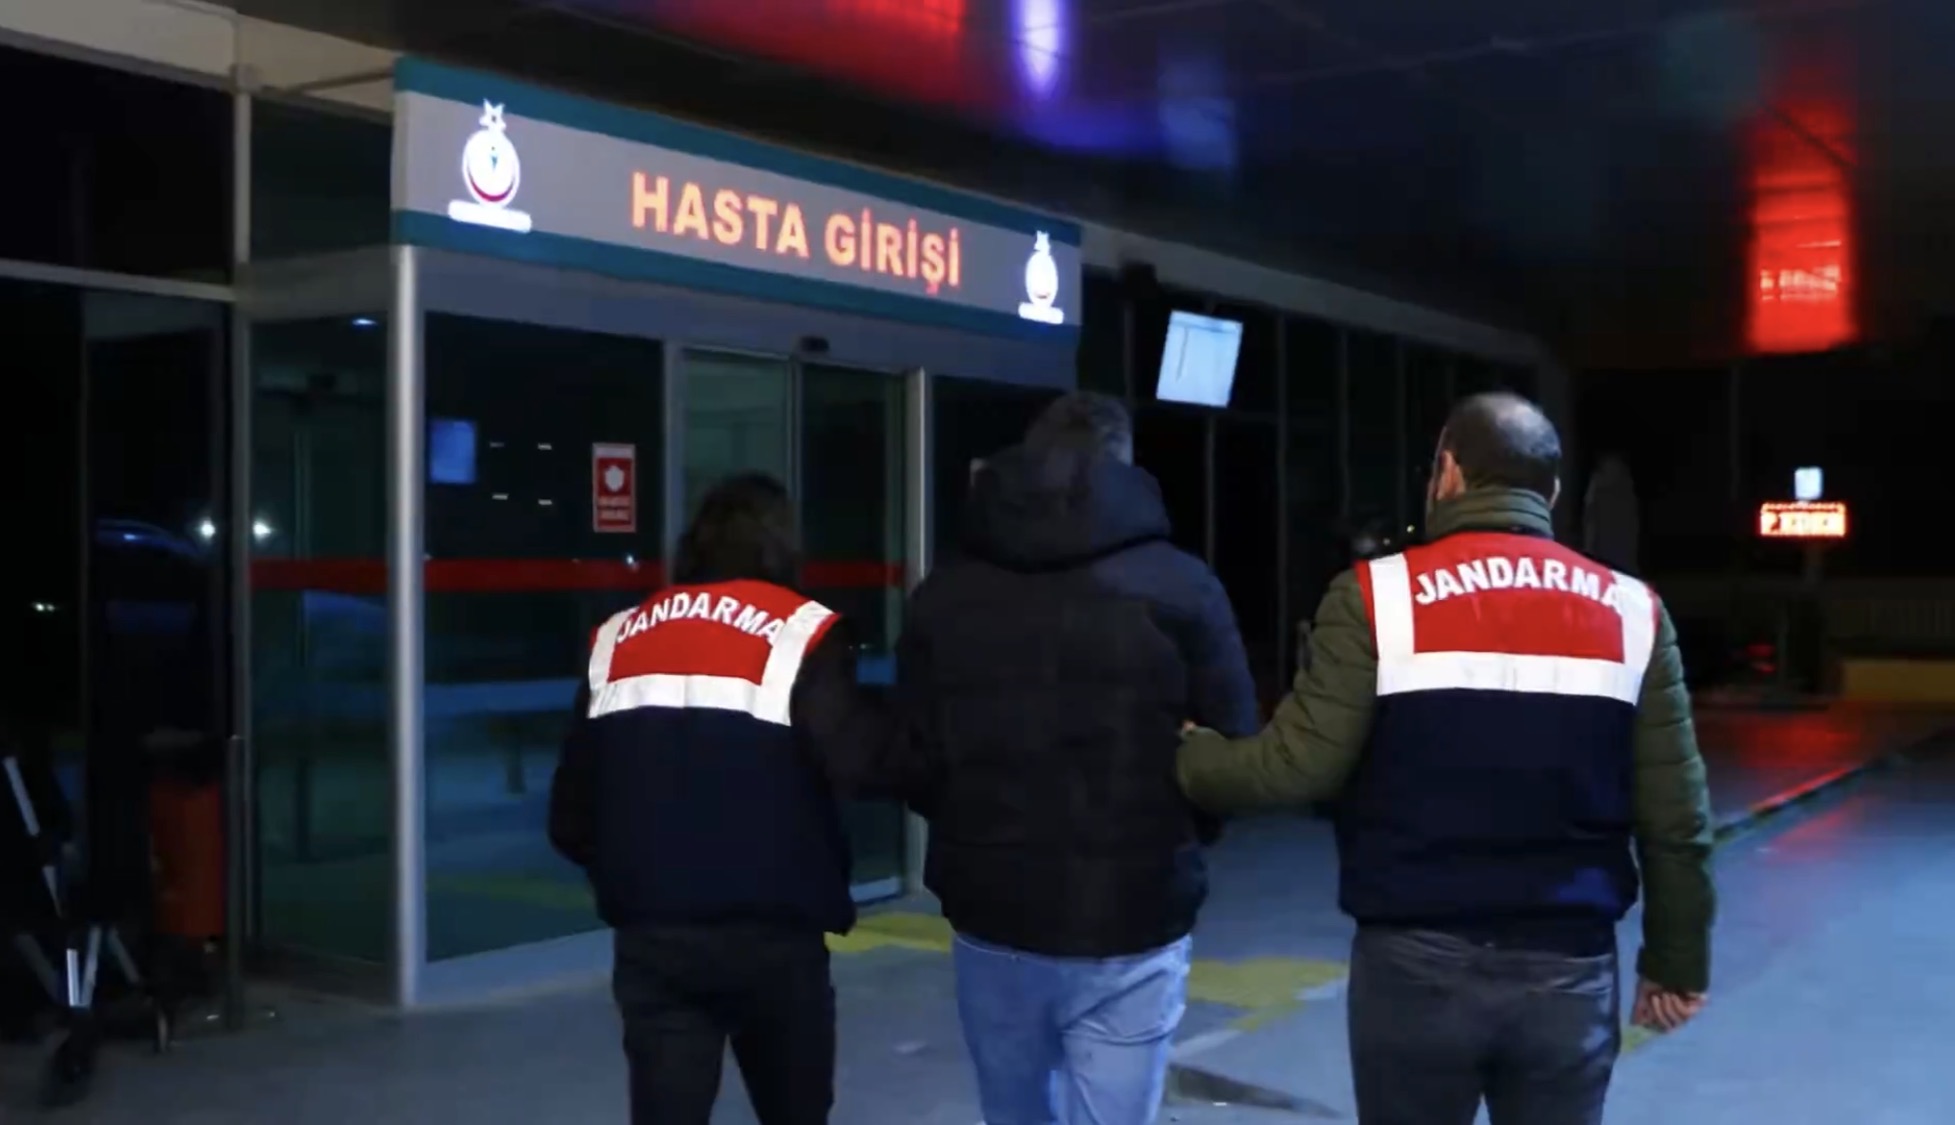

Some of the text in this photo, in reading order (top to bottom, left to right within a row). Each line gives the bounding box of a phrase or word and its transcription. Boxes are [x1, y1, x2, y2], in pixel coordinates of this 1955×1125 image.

[632, 171, 960, 295] HASTA GİRİŞİ
[616, 592, 786, 645] JANDARMA
